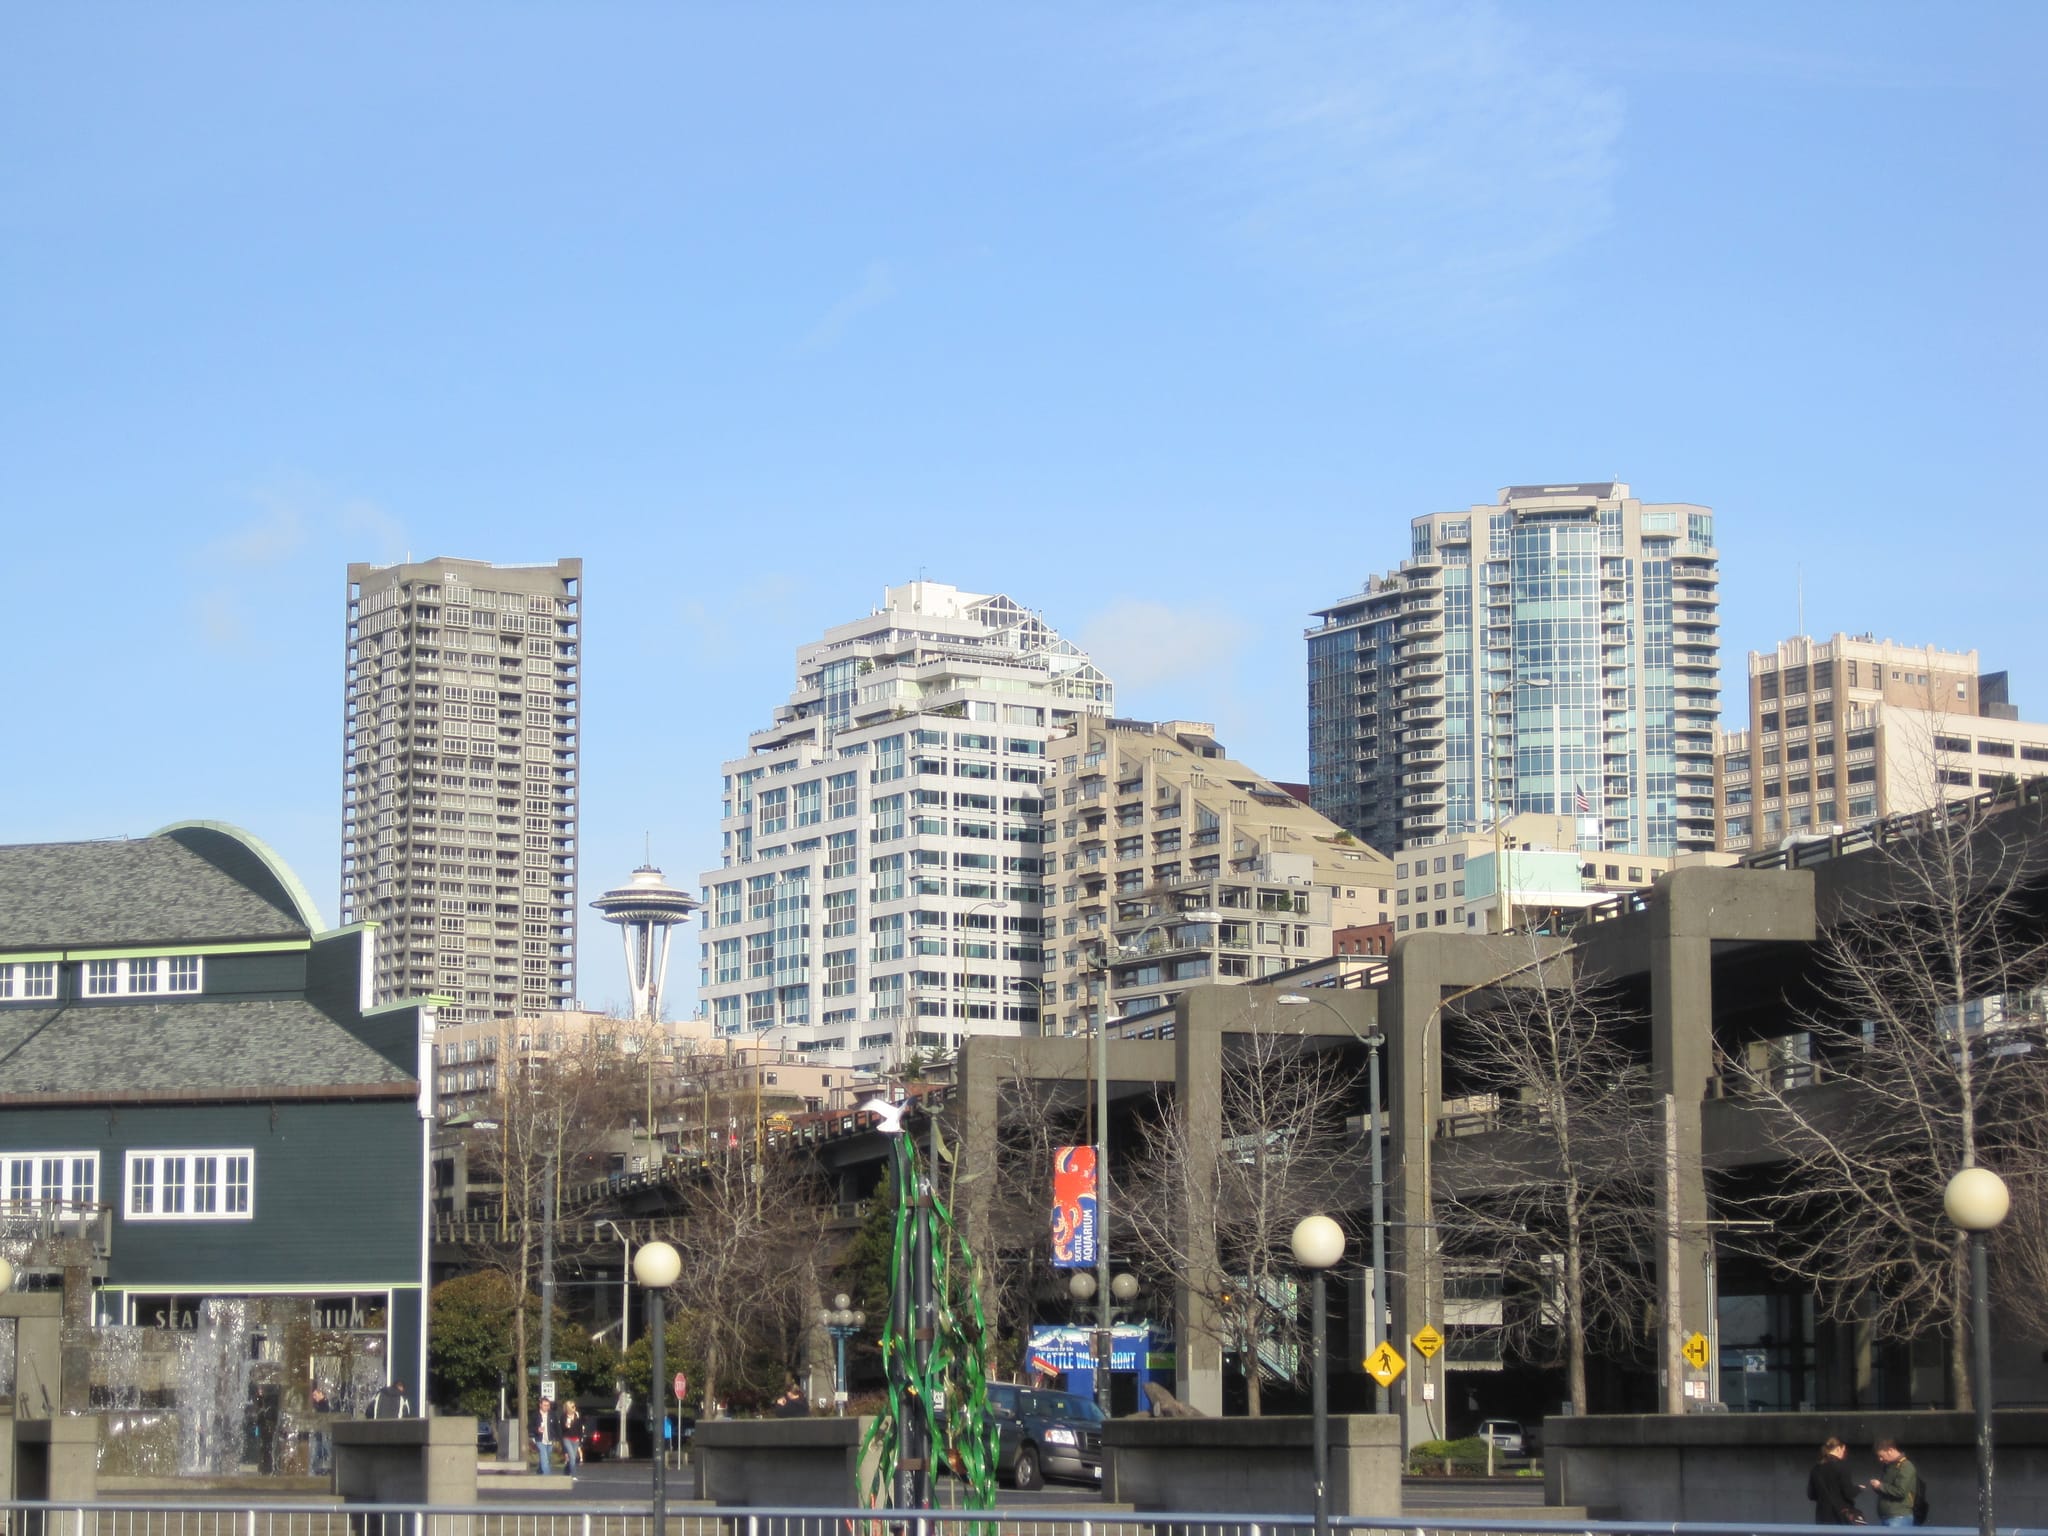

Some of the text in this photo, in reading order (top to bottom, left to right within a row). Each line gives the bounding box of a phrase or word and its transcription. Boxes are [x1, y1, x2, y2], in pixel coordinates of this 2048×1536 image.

[1074, 1234, 1082, 1262] SEATTLE
[1082, 1209, 1093, 1262] AQUARIUM
[310, 1309, 365, 1329] RIUM
